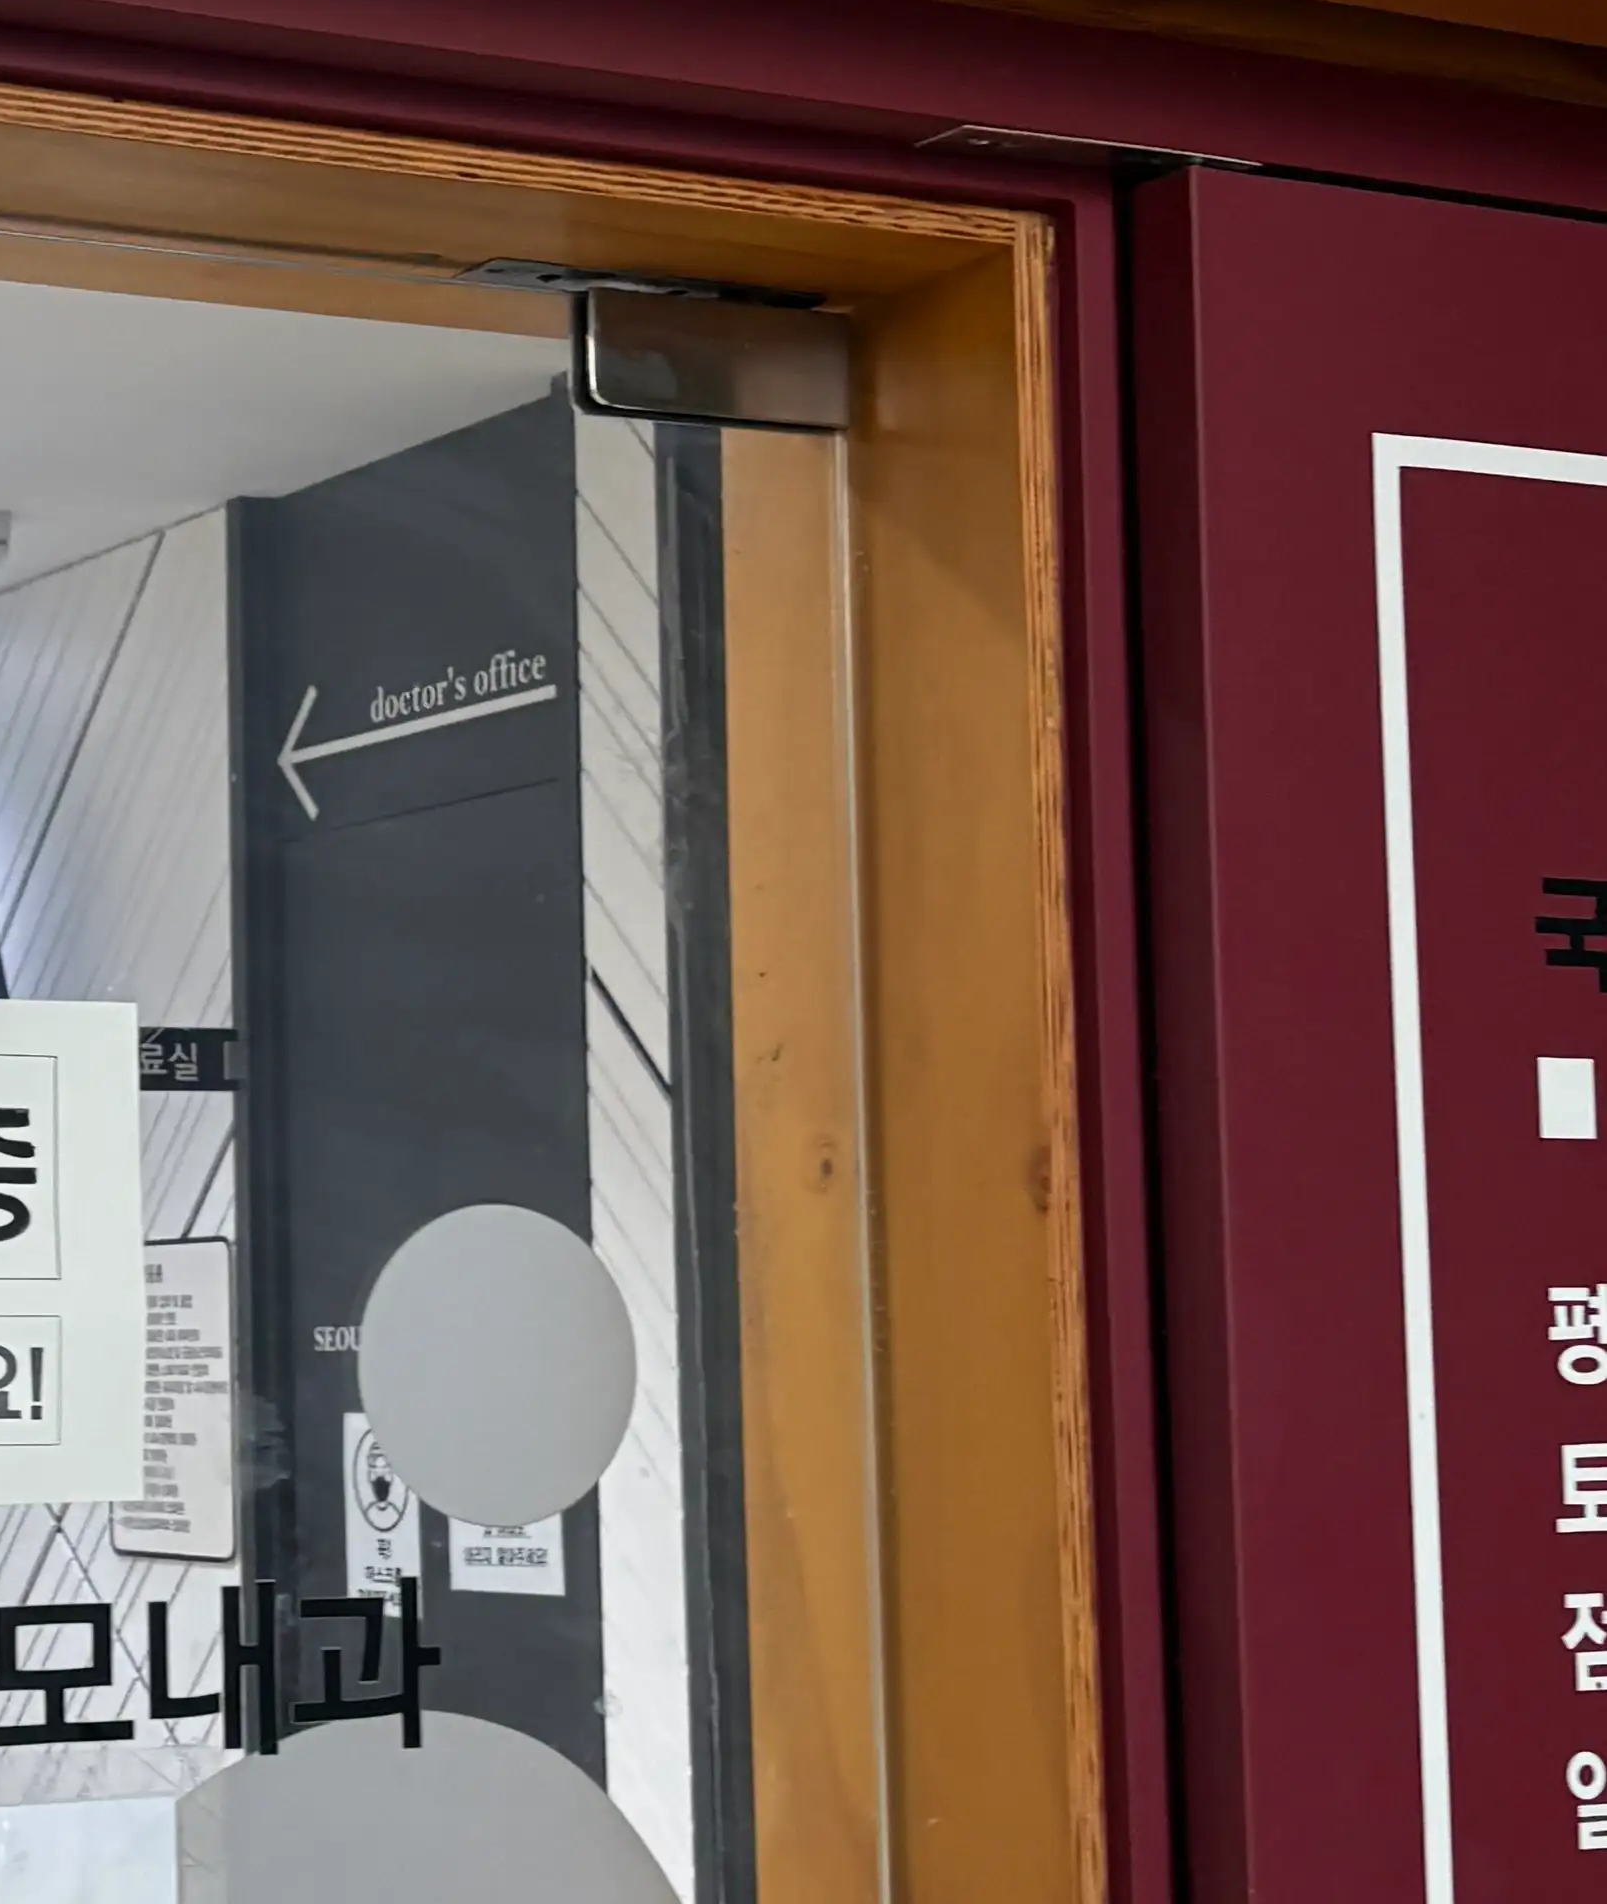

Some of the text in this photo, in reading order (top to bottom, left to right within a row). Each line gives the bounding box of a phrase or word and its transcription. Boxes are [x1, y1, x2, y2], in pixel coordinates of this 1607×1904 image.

[370, 649, 547, 723] doctor's office
[138, 1042, 200, 1082] 료실
[313, 1325, 362, 1352] SEOU
